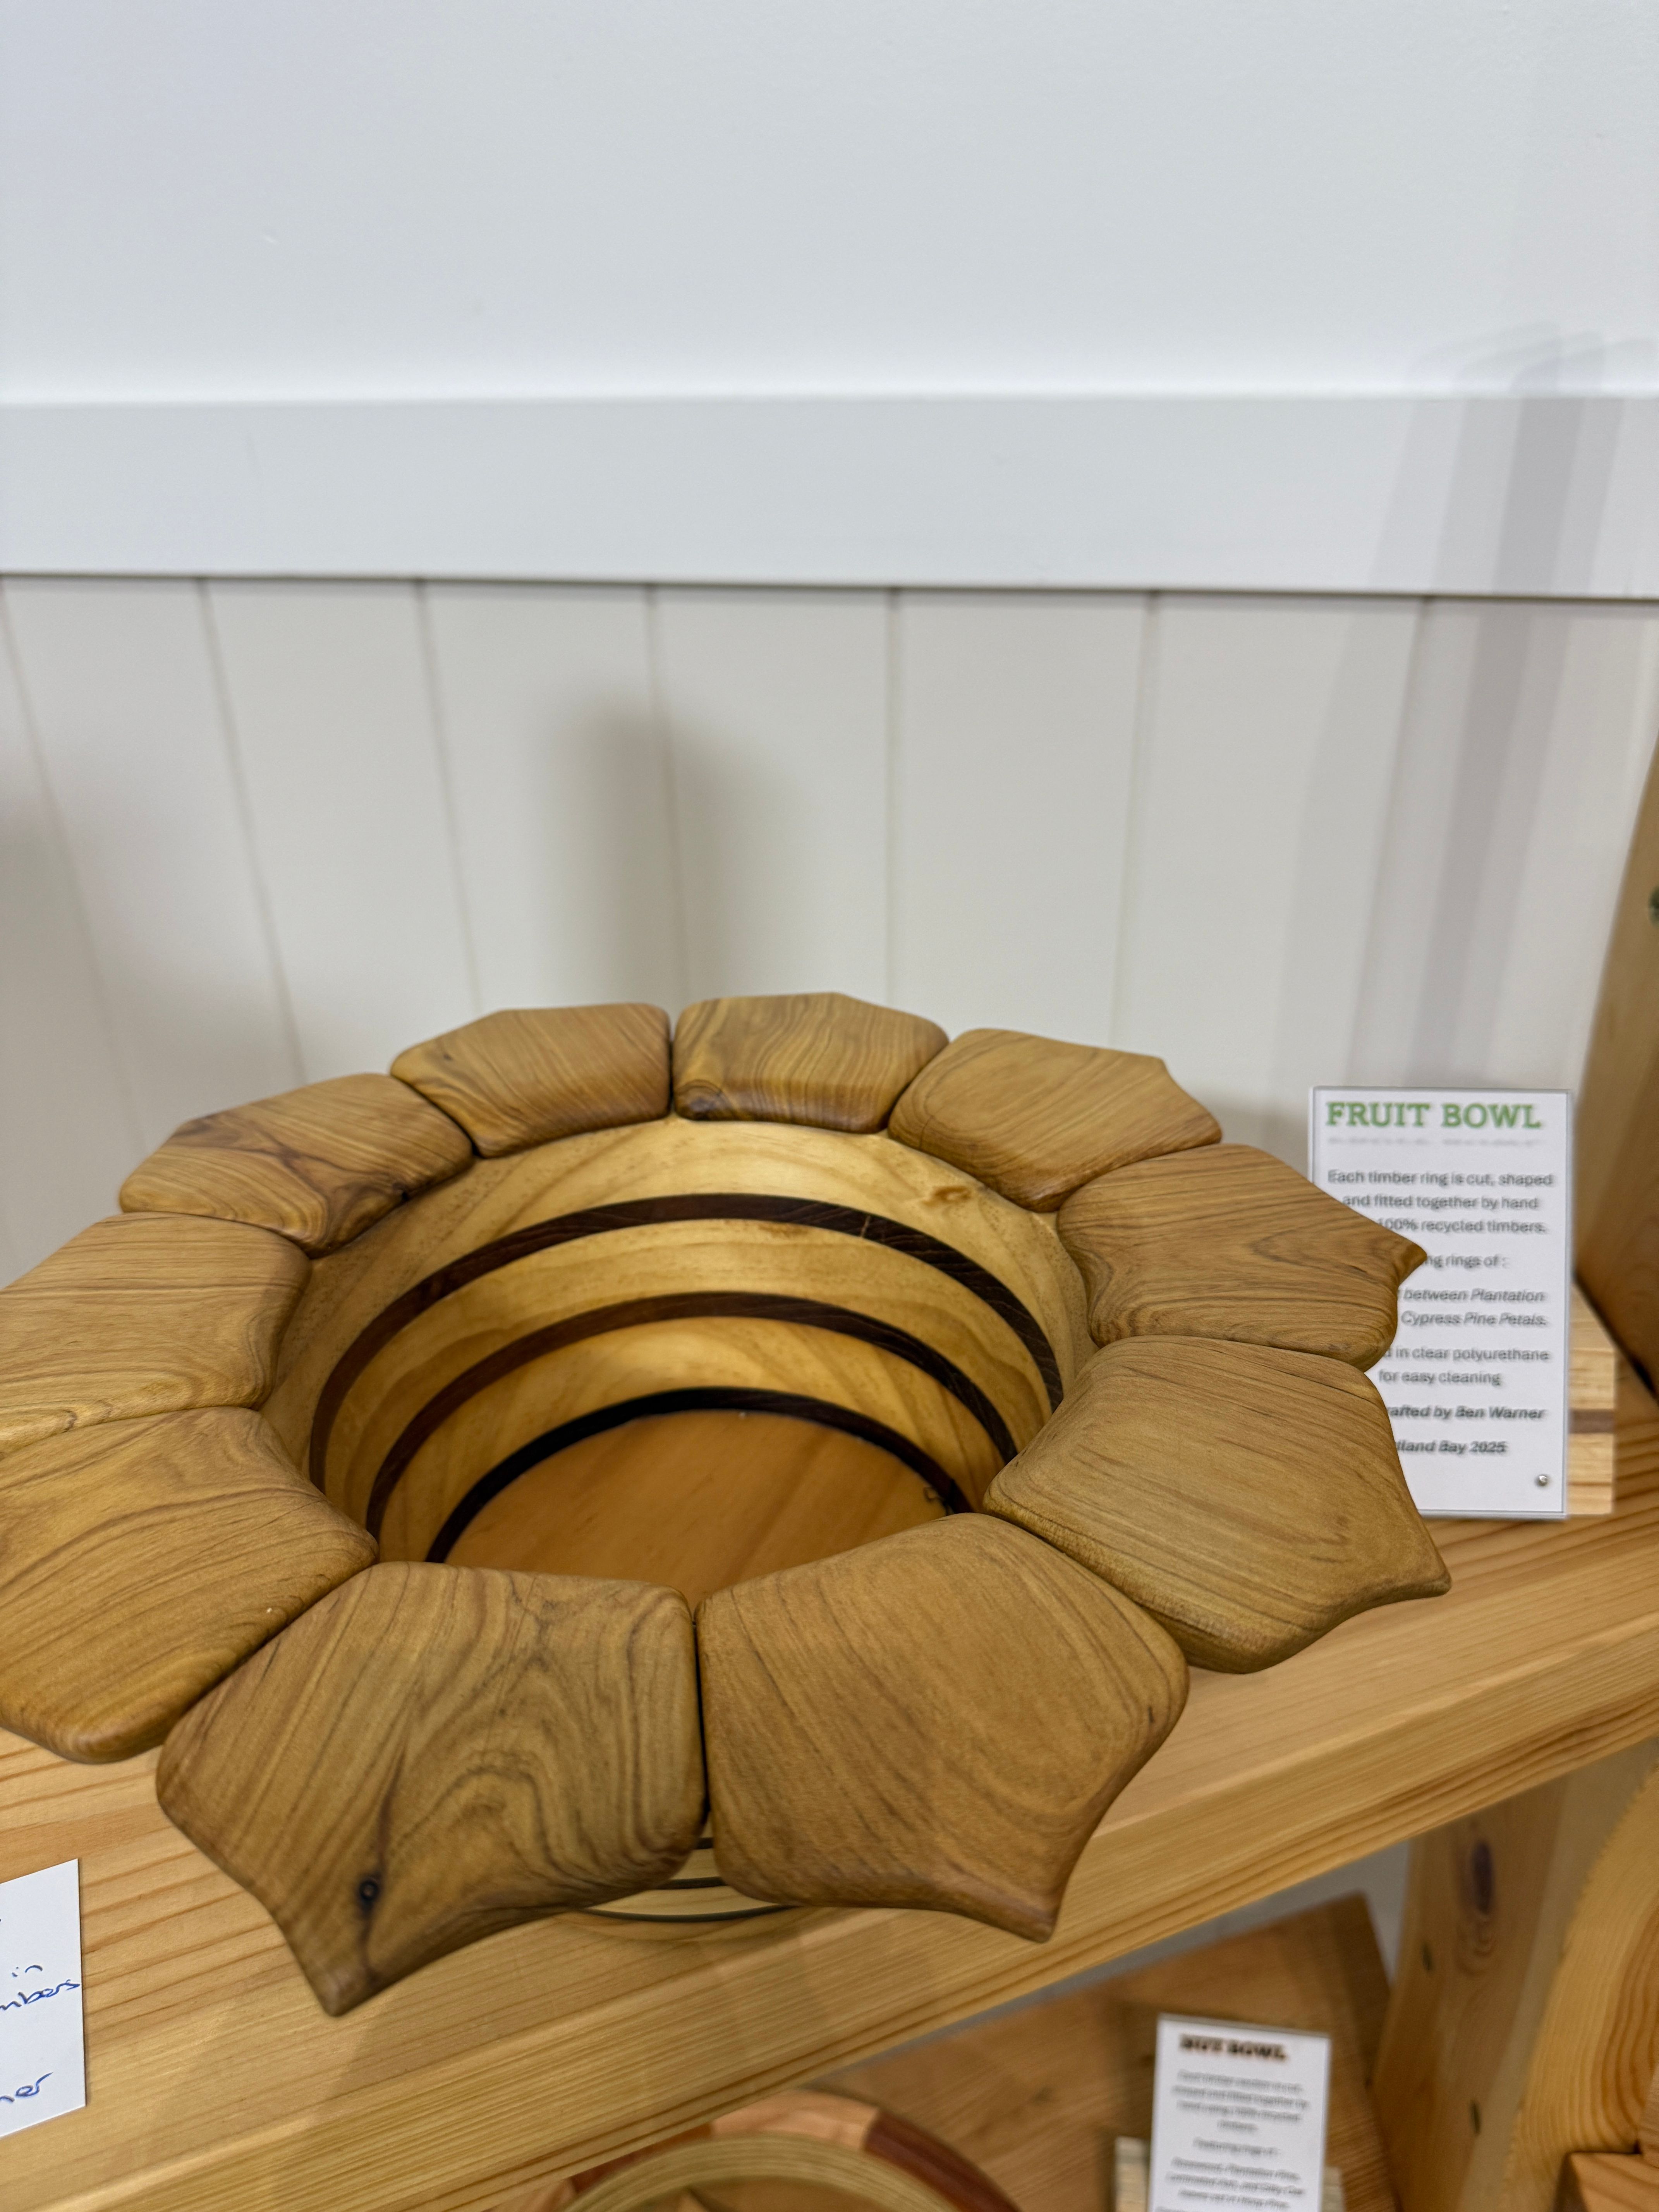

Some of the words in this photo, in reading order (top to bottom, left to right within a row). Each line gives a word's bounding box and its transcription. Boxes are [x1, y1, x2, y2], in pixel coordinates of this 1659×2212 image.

[1326, 1101, 1432, 1128] FRUIT
[1441, 1102, 1543, 1130] BOWL
[1328, 1169, 1366, 1185] Each
[1367, 1170, 1418, 1186] timber
[1420, 1172, 1448, 1189] ring
[1450, 1172, 1465, 1186] is
[1465, 1173, 1496, 1187] cut,
[1498, 1173, 1555, 1188] shaped
[1342, 1195, 1370, 1207] and
[1373, 1193, 1414, 1209] fitted
[1415, 1195, 1478, 1212] together
[1480, 1195, 1500, 1212] by
[1501, 1196, 1541, 1211] hand
[1420, 1219, 1484, 1235] recycled
[1486, 1219, 1549, 1235] timbers.
[1445, 1254, 1483, 1271] rings
[1483, 1254, 1502, 1269] of
[1403, 1289, 1467, 1303] between
[1470, 1288, 1547, 1304] Plantation
[1399, 1310, 1463, 1328] Cypress
[1463, 1311, 1499, 1328] Pine
[1396, 1345, 1410, 1360] in
[1412, 1346, 1450, 1361] clear
[1452, 1347, 1552, 1364] polyurethane
[1378, 1369, 1400, 1385] for
[1401, 1371, 1436, 1386] easy
[1437, 1370, 1504, 1389] cleaning
[1432, 1405, 1453, 1421] by
[1454, 1405, 1486, 1420] Ben
[1489, 1406, 1546, 1421] Warner
[1437, 1439, 1468, 1456] Bay
[1468, 1440, 1508, 1456] 2025
[0, 1979, 80, 2011] mbers
